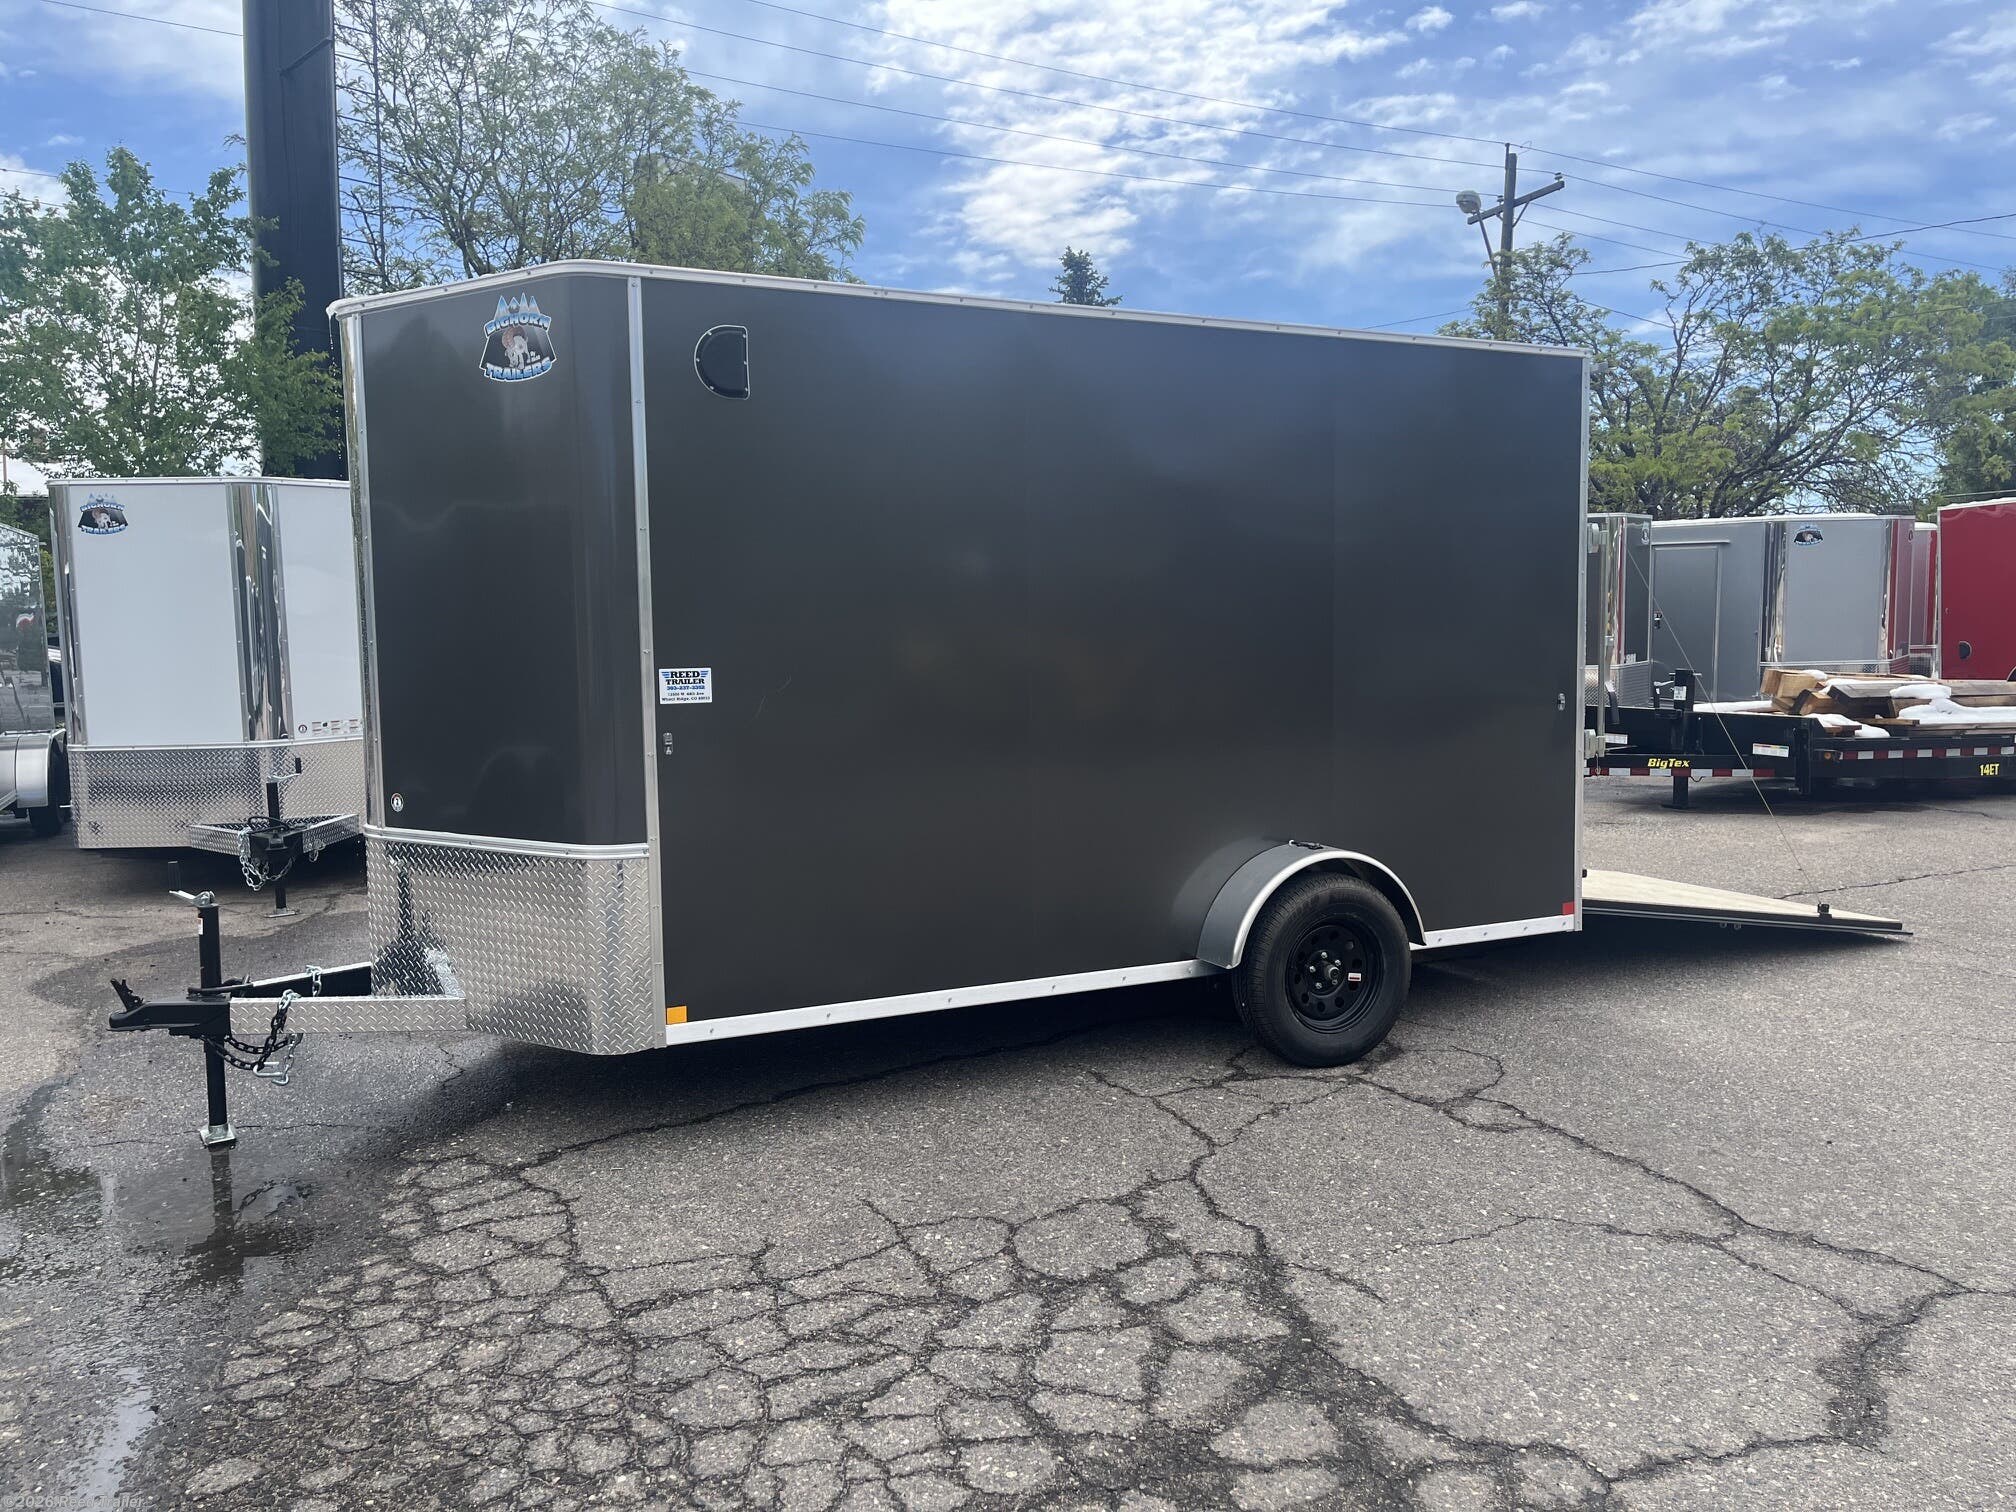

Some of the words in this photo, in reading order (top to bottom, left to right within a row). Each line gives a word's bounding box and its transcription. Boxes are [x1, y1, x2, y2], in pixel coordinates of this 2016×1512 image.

[485, 312, 551, 335] BIGHORN
[486, 357, 551, 380] TRAILERS
[1647, 758, 1690, 769] BigTex
[1979, 763, 2000, 776] 14ET
